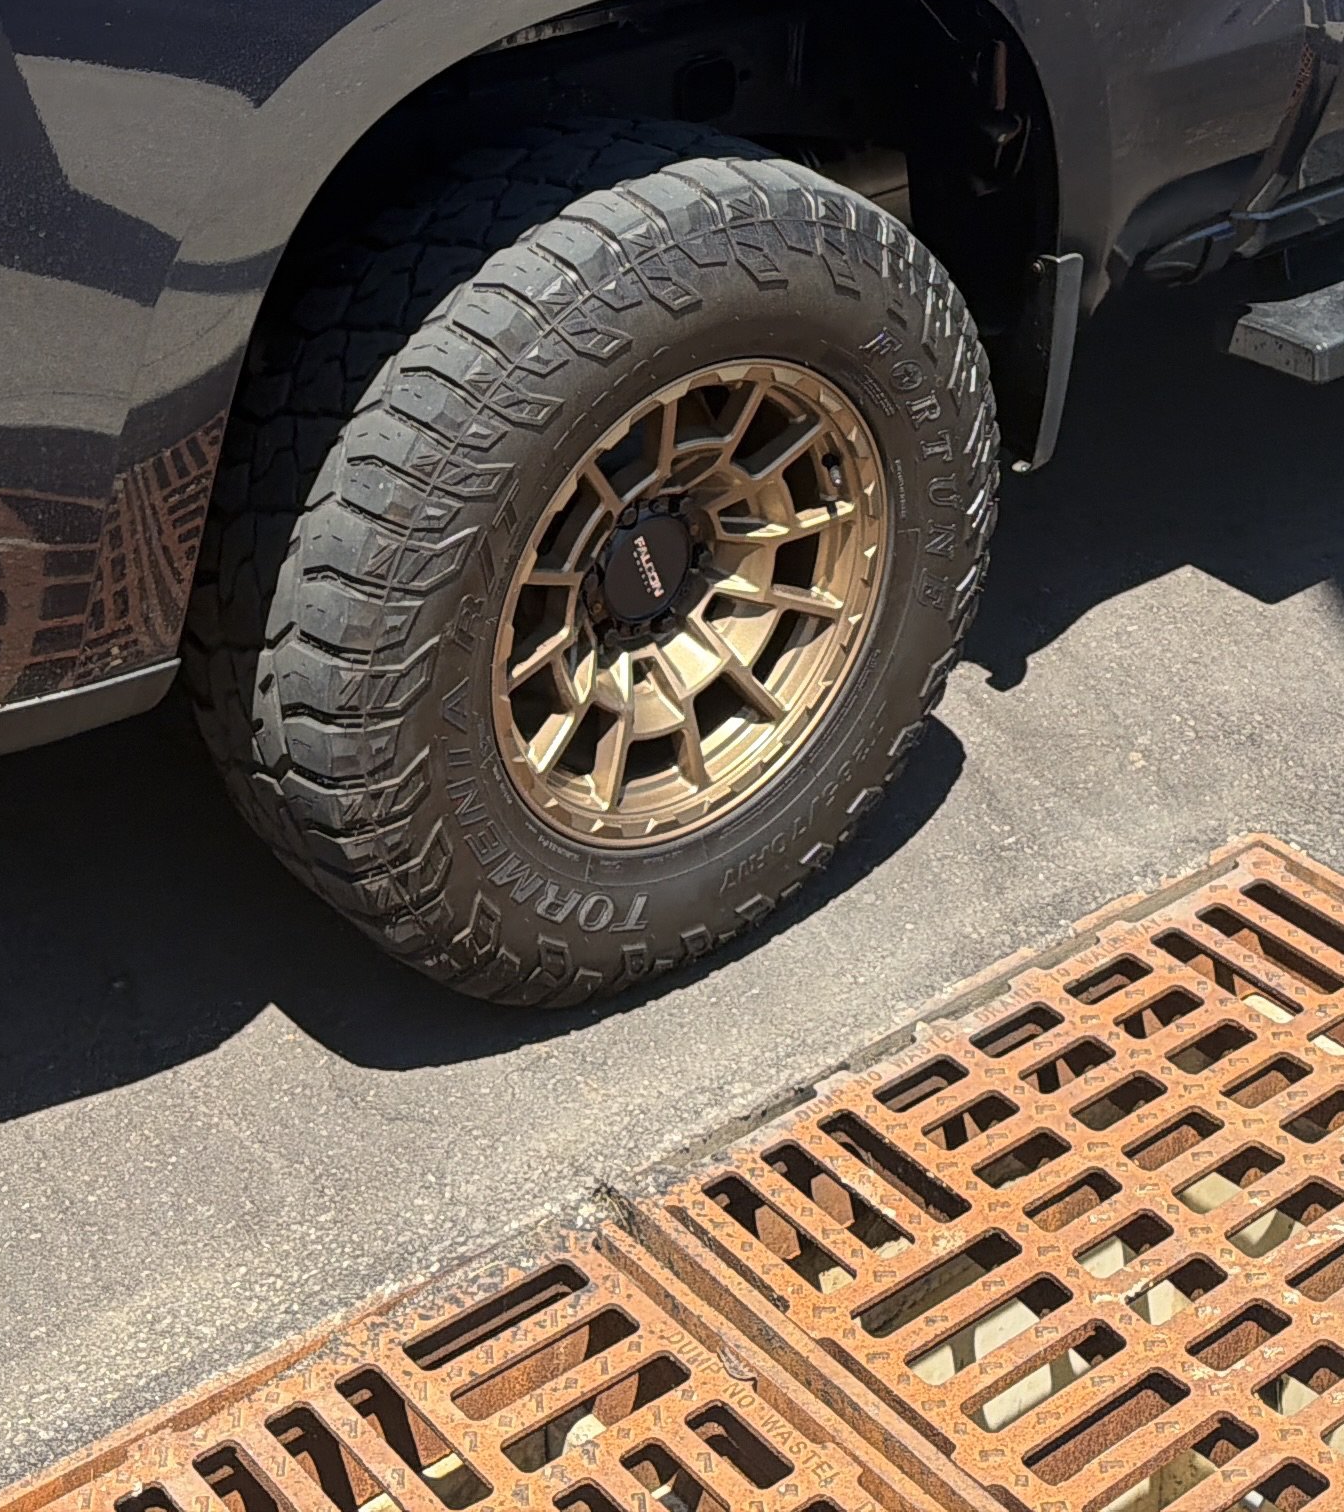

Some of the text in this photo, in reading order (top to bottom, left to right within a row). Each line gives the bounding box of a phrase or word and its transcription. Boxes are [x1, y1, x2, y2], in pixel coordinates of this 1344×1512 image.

[859, 327, 960, 609] FORTUNE
[633, 535, 665, 598] FALCON
[441, 676, 650, 933] TORMENTA
[795, 1088, 846, 1123] DUMP
[854, 1070, 883, 1091] NO
[973, 981, 1041, 1023] DRAINS
[1044, 966, 1071, 983] TO
[665, 1330, 724, 1375] DUMP
[721, 1381, 756, 1410] NO
